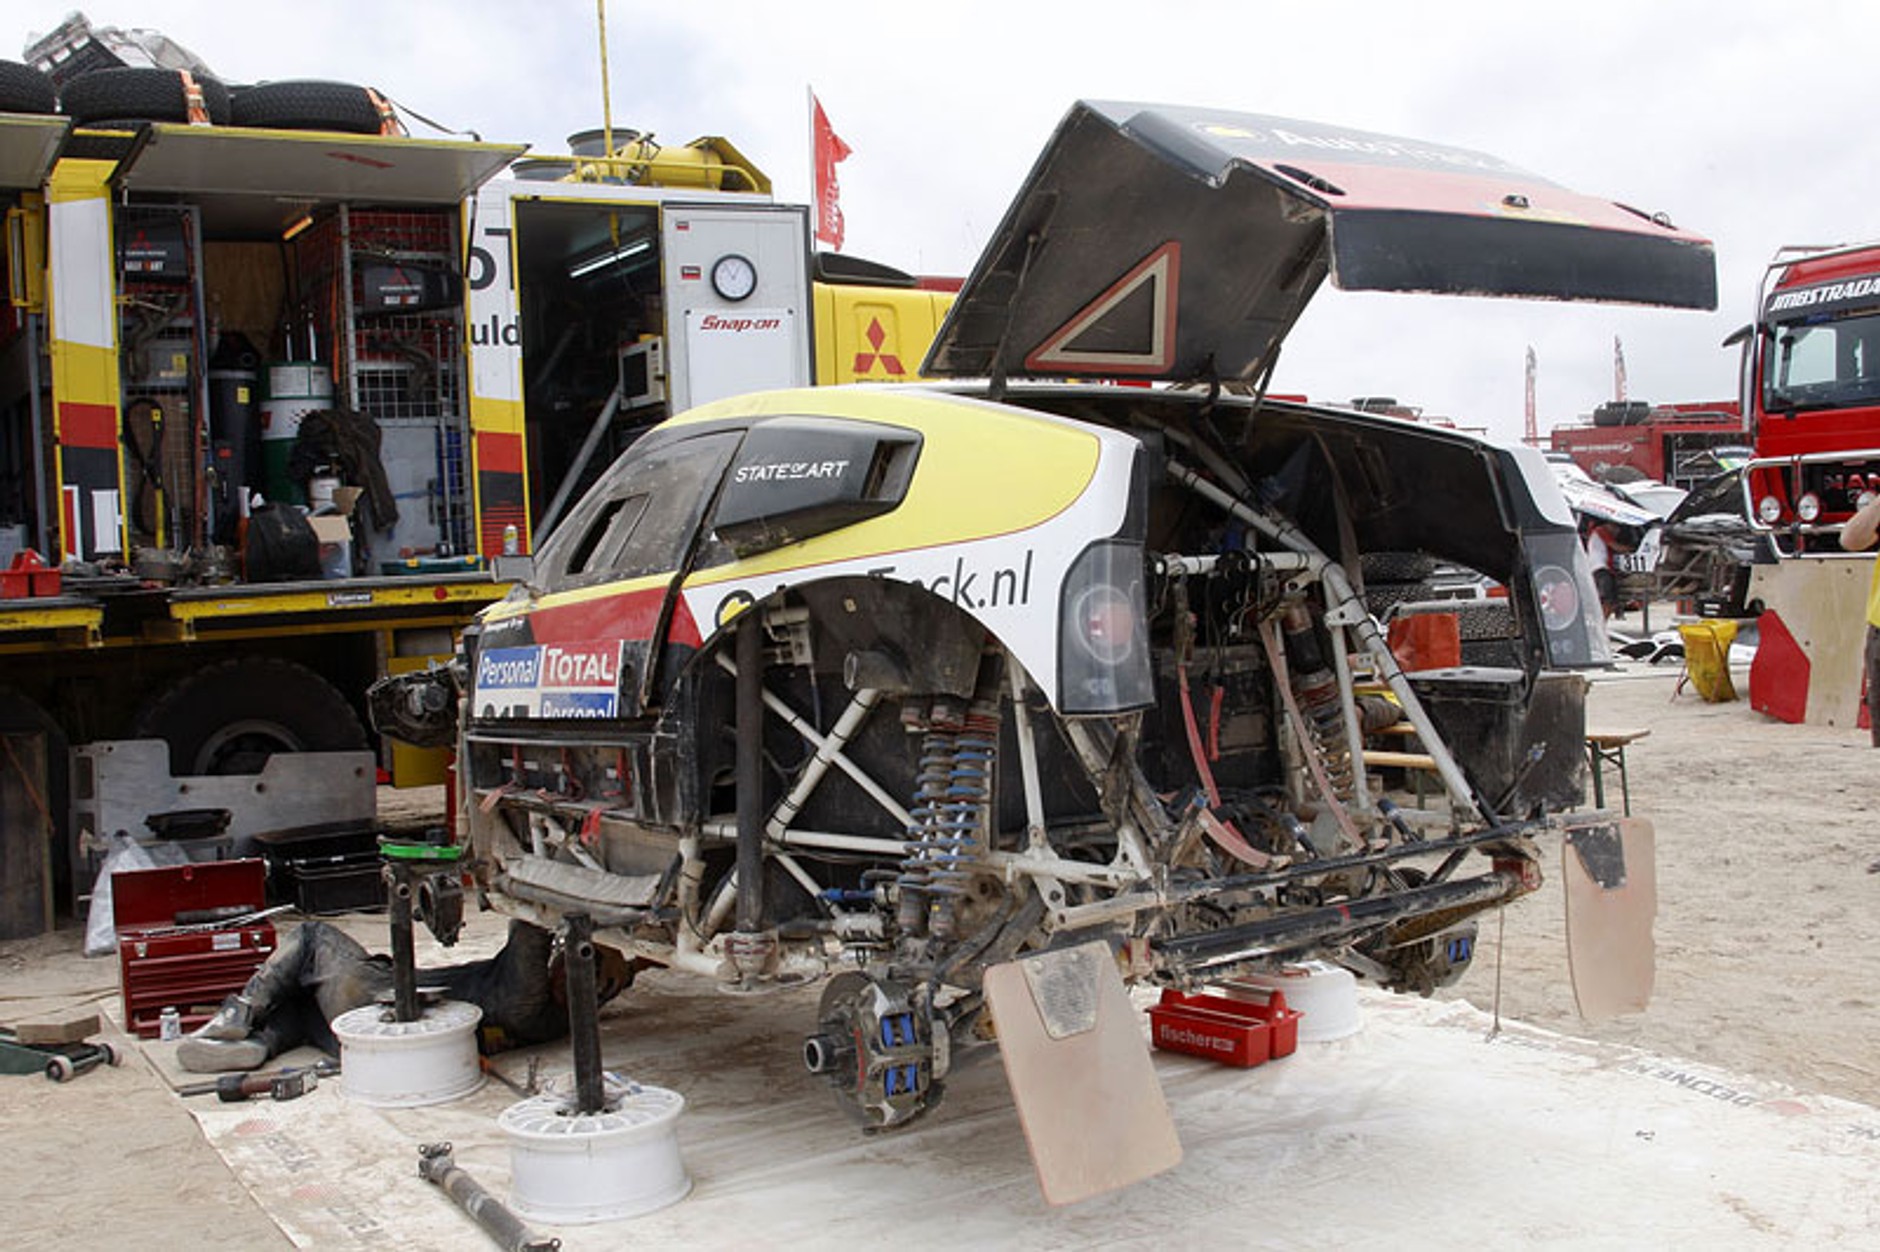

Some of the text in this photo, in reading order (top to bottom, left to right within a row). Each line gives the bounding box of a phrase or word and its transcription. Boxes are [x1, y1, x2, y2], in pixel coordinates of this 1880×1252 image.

[700, 315, 781, 332] Snap-on
[735, 463, 790, 482] STATE
[806, 460, 850, 479] ART
[1623, 554, 1646, 572] 311
[480, 650, 540, 685] Personal
[547, 648, 614, 682] TOTAL
[1160, 1024, 1215, 1049] fischer
